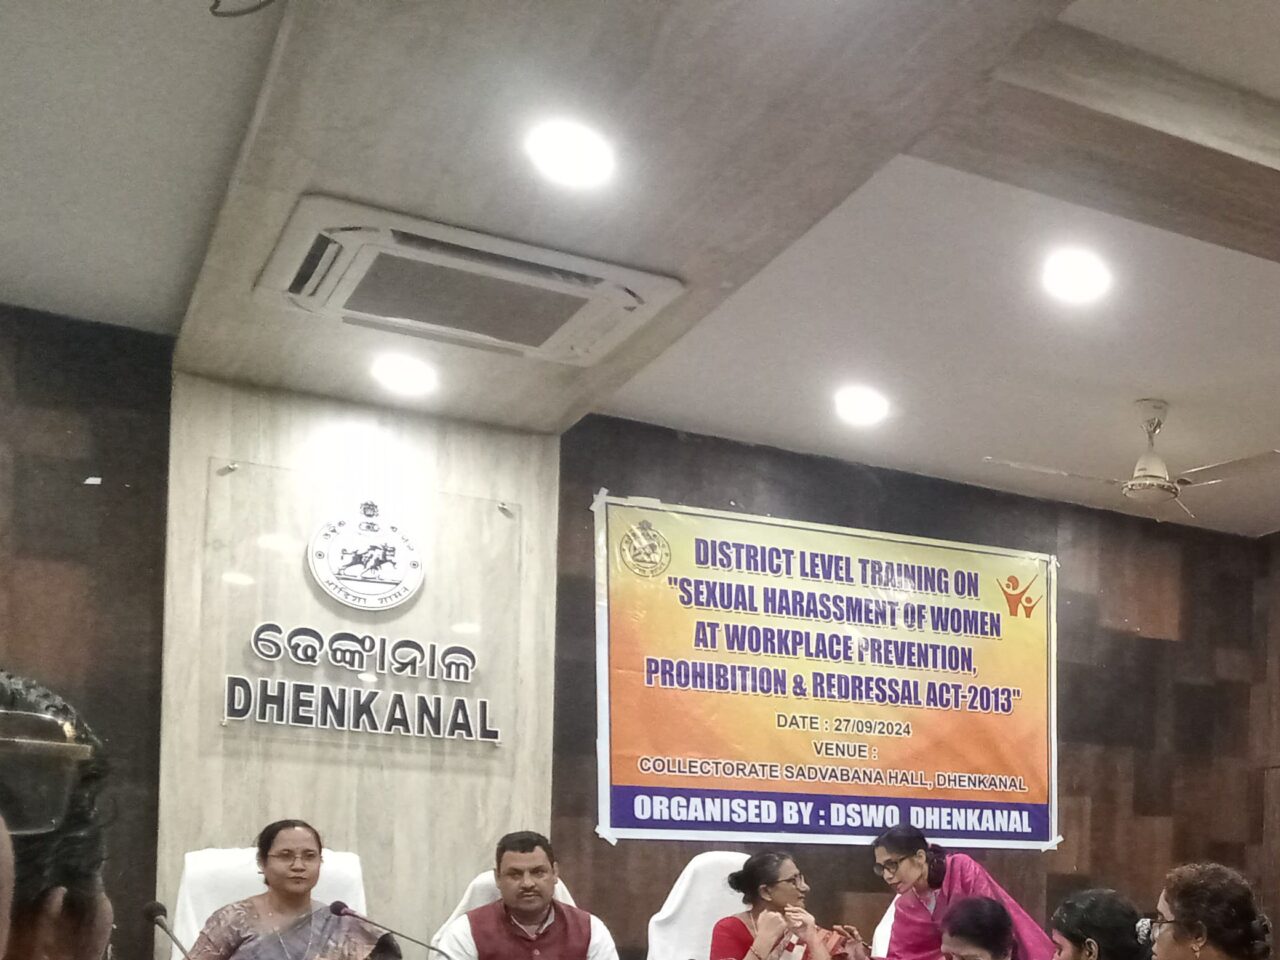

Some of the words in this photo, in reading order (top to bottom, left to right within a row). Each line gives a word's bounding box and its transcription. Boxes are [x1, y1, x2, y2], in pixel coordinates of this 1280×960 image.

[694, 537, 795, 577] DISTRICT
[799, 550, 855, 584] LEVEL
[858, 558, 950, 595] TRAINING
[953, 570, 980, 598] ON
[667, 576, 759, 612] "SEXUAL
[763, 587, 899, 627] HARASSMENT
[903, 602, 927, 630] OF
[930, 605, 1002, 638] WOMEN
[694, 620, 720, 649] AT
[724, 623, 853, 662] WORKPLACE
[858, 636, 977, 676] PREVENTION,
[224, 675, 501, 741] DHENKANAL
[645, 657, 787, 696] PROHIBITION
[792, 673, 807, 697] &
[811, 671, 922, 707] REDRESSAL
[925, 681, 1021, 714] ACT-2013"
[776, 713, 820, 730] DATE
[833, 718, 912, 737] 27/09/2024
[813, 741, 868, 759] VENUE
[638, 756, 780, 779] COLLECTORATE
[783, 764, 883, 785] SADVABANA
[888, 770, 933, 789] HALL,
[936, 773, 1028, 792] DHENKANAL
[633, 794, 778, 825] ORGANISED
[782, 800, 815, 826] BY
[909, 806, 1032, 833] DHENKANAL
